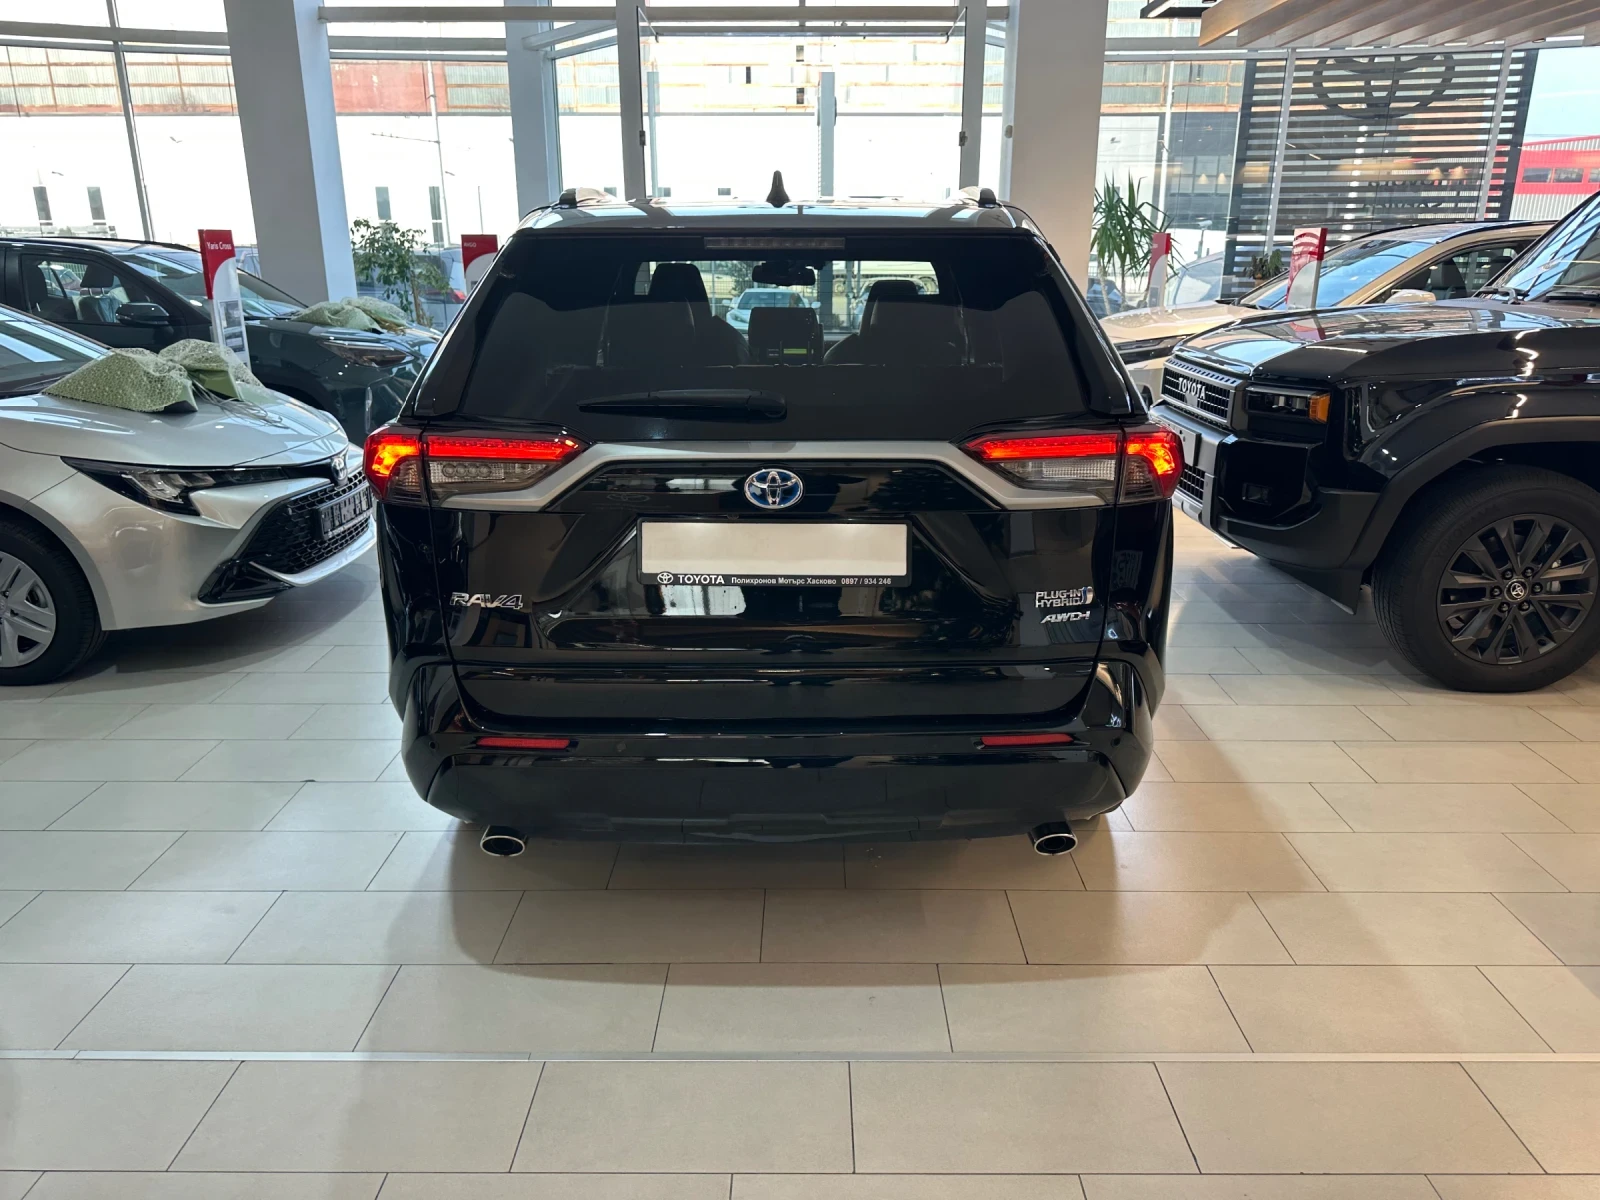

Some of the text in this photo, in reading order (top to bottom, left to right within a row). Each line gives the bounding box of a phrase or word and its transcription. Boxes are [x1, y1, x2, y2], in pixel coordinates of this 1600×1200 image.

[206, 241, 232, 249] Yaris Cross
[1178, 377, 1206, 400] TOYOTA
[677, 574, 725, 585] TOYOTA
[731, 577, 777, 586] Полихронов
[778, 577, 806, 586] Мотърс
[806, 577, 837, 586] Хасково
[840, 577, 859, 585] 0897
[864, 577, 877, 585] 934
[1035, 588, 1083, 600] PLUG-IN
[449, 591, 524, 610] RAV4
[1035, 597, 1082, 608] HYBRID
